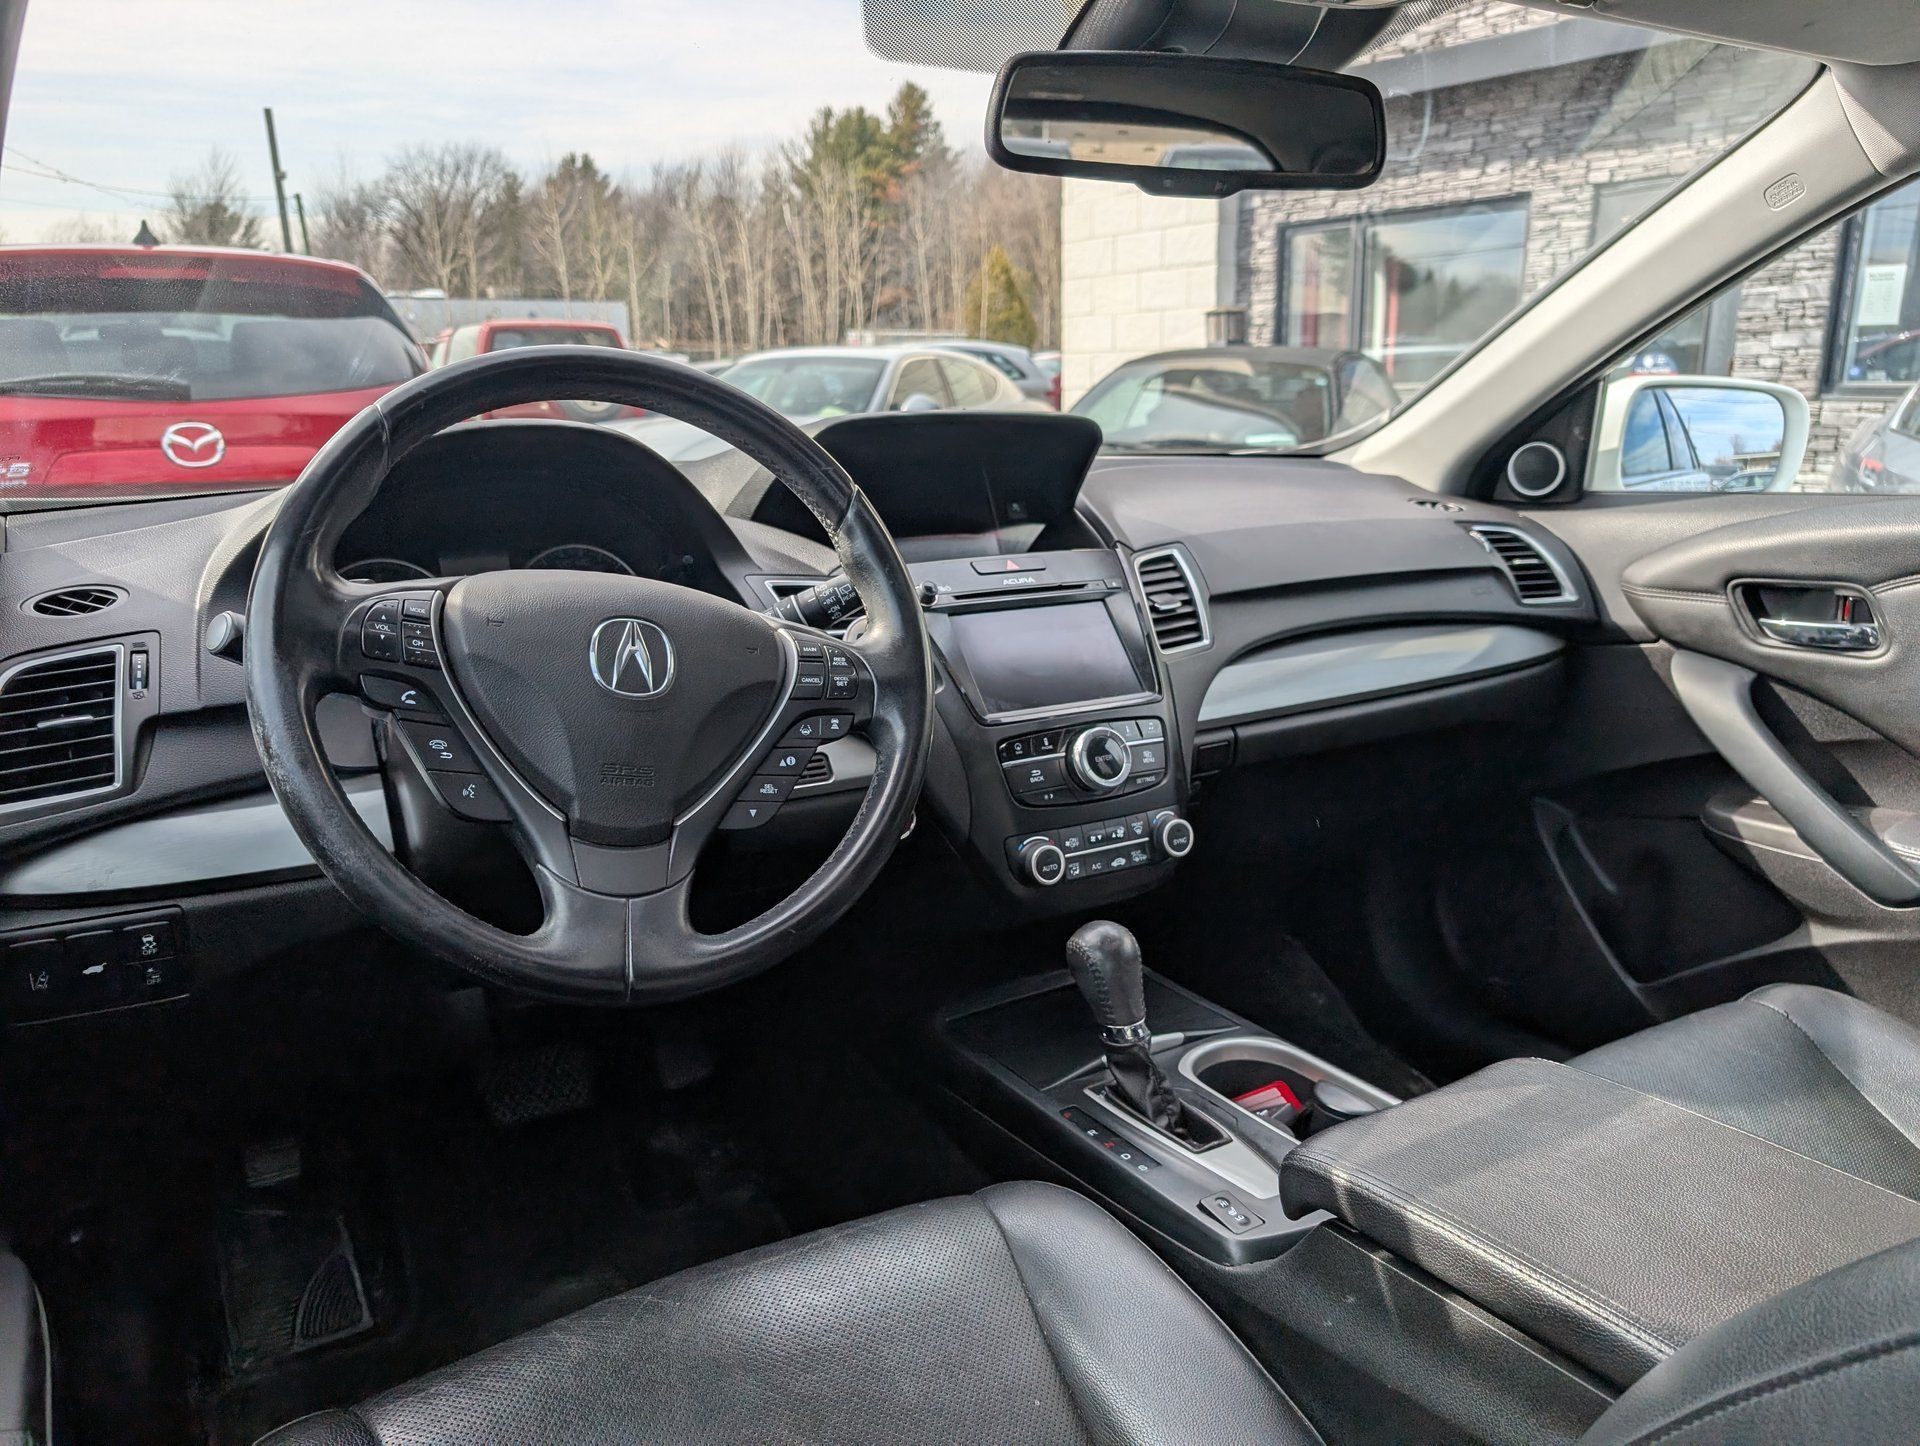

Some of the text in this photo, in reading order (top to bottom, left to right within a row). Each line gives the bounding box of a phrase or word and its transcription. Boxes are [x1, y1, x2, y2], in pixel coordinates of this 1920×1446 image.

[1003, 577, 1036, 585] ACURA
[825, 595, 837, 604] INT
[409, 606, 426, 614] MODE
[830, 604, 841, 613] ON
[374, 623, 391, 632] VOL
[412, 639, 424, 647] CH
[1094, 754, 1113, 763] ENTER
[1029, 776, 1044, 784] BACK
[1136, 776, 1156, 784] SETTINGS
[1173, 837, 1187, 846] SYNC
[1042, 863, 1059, 872] AUTO
[142, 948, 158, 956] OFF
[1087, 1129, 1099, 1137] R
